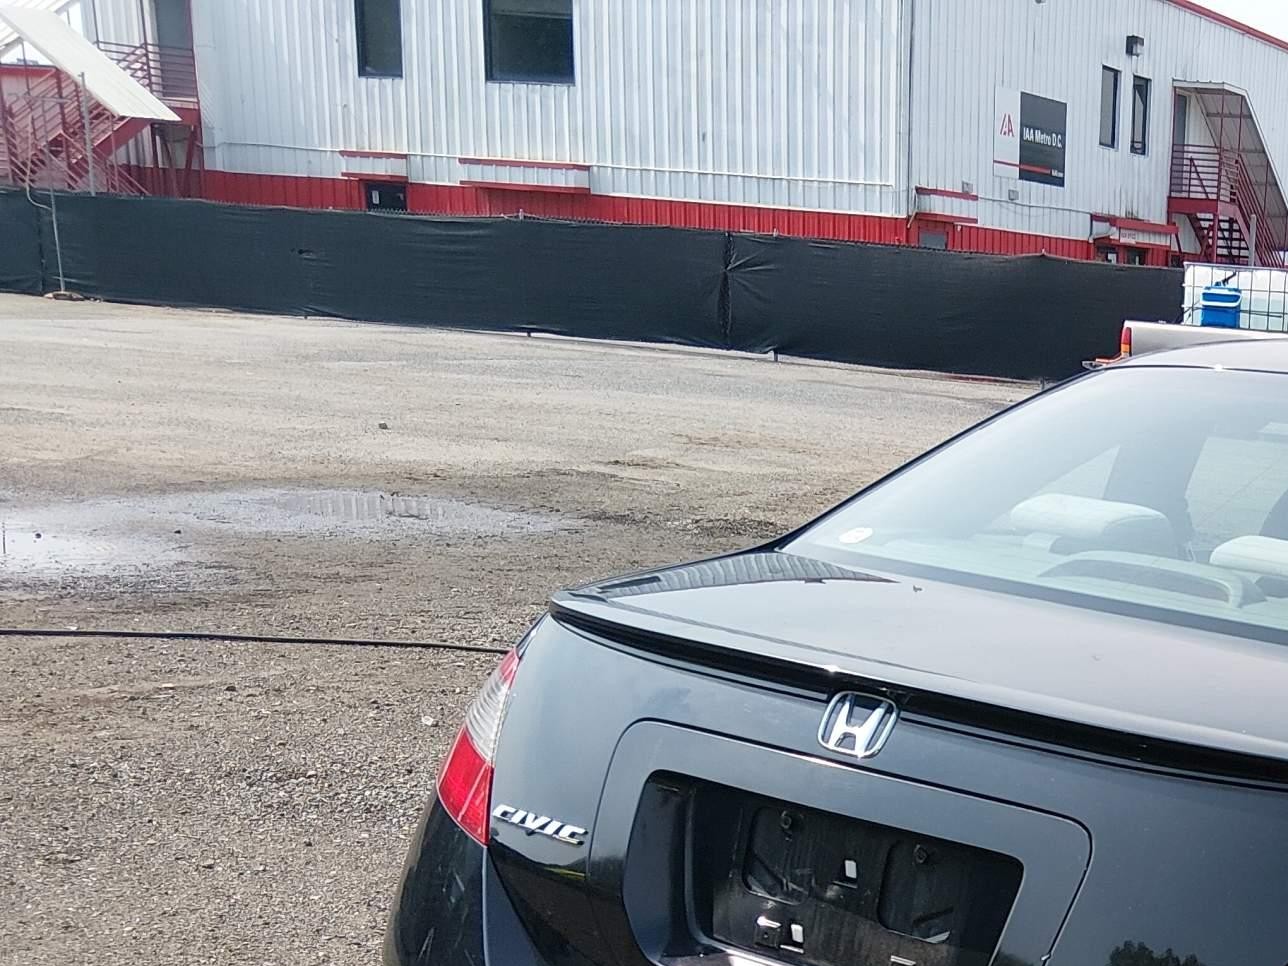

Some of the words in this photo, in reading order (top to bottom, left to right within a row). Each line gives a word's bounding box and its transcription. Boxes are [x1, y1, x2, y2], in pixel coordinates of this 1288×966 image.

[1023, 127, 1034, 142] IAA
[1035, 129, 1052, 146] Metro
[492, 803, 589, 847] CIVIC
